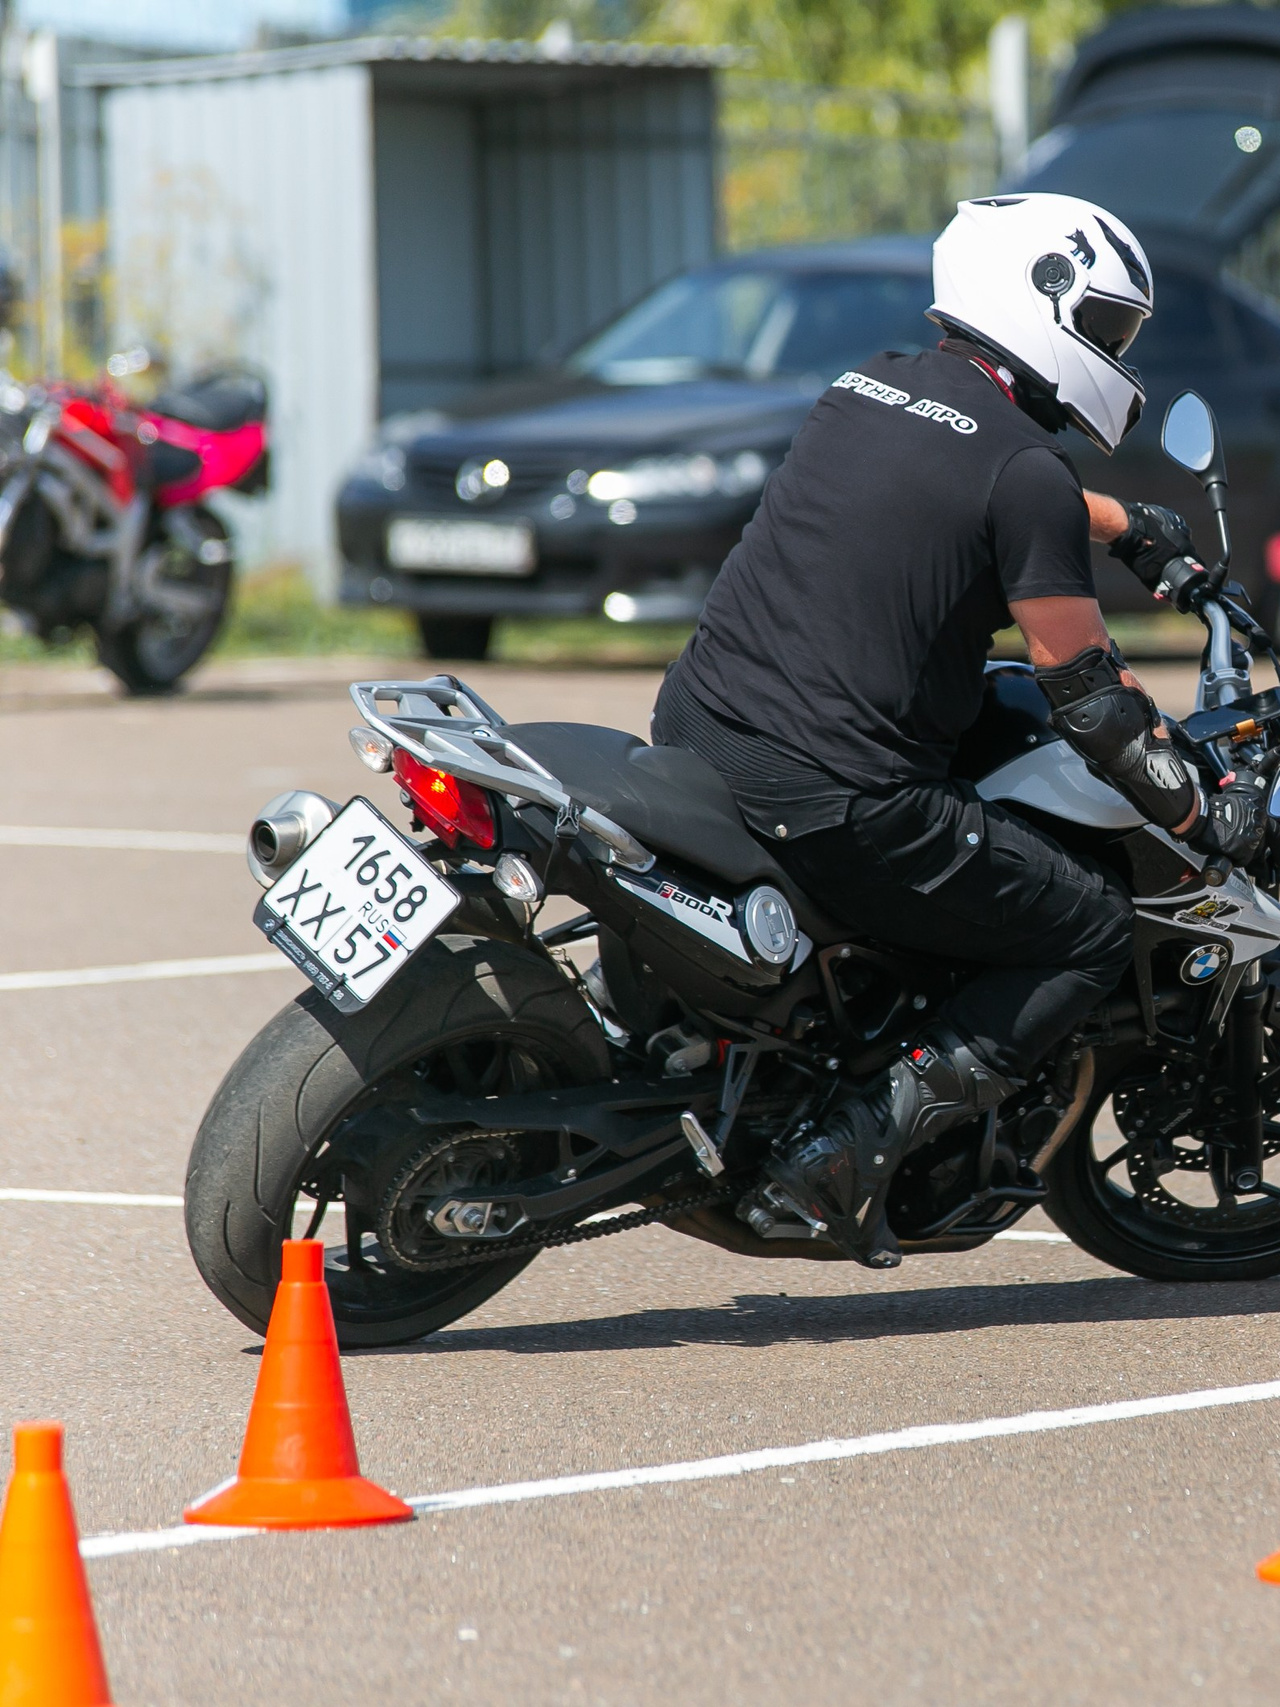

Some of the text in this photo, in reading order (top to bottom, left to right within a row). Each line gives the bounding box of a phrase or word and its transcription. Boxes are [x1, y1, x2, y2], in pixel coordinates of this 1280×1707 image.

[832, 371, 978, 434] АРТНЕР АГРО
[344, 835, 428, 923] 1658
[276, 868, 346, 941] XX
[333, 923, 392, 980] 57
[358, 901, 390, 933] RUS
